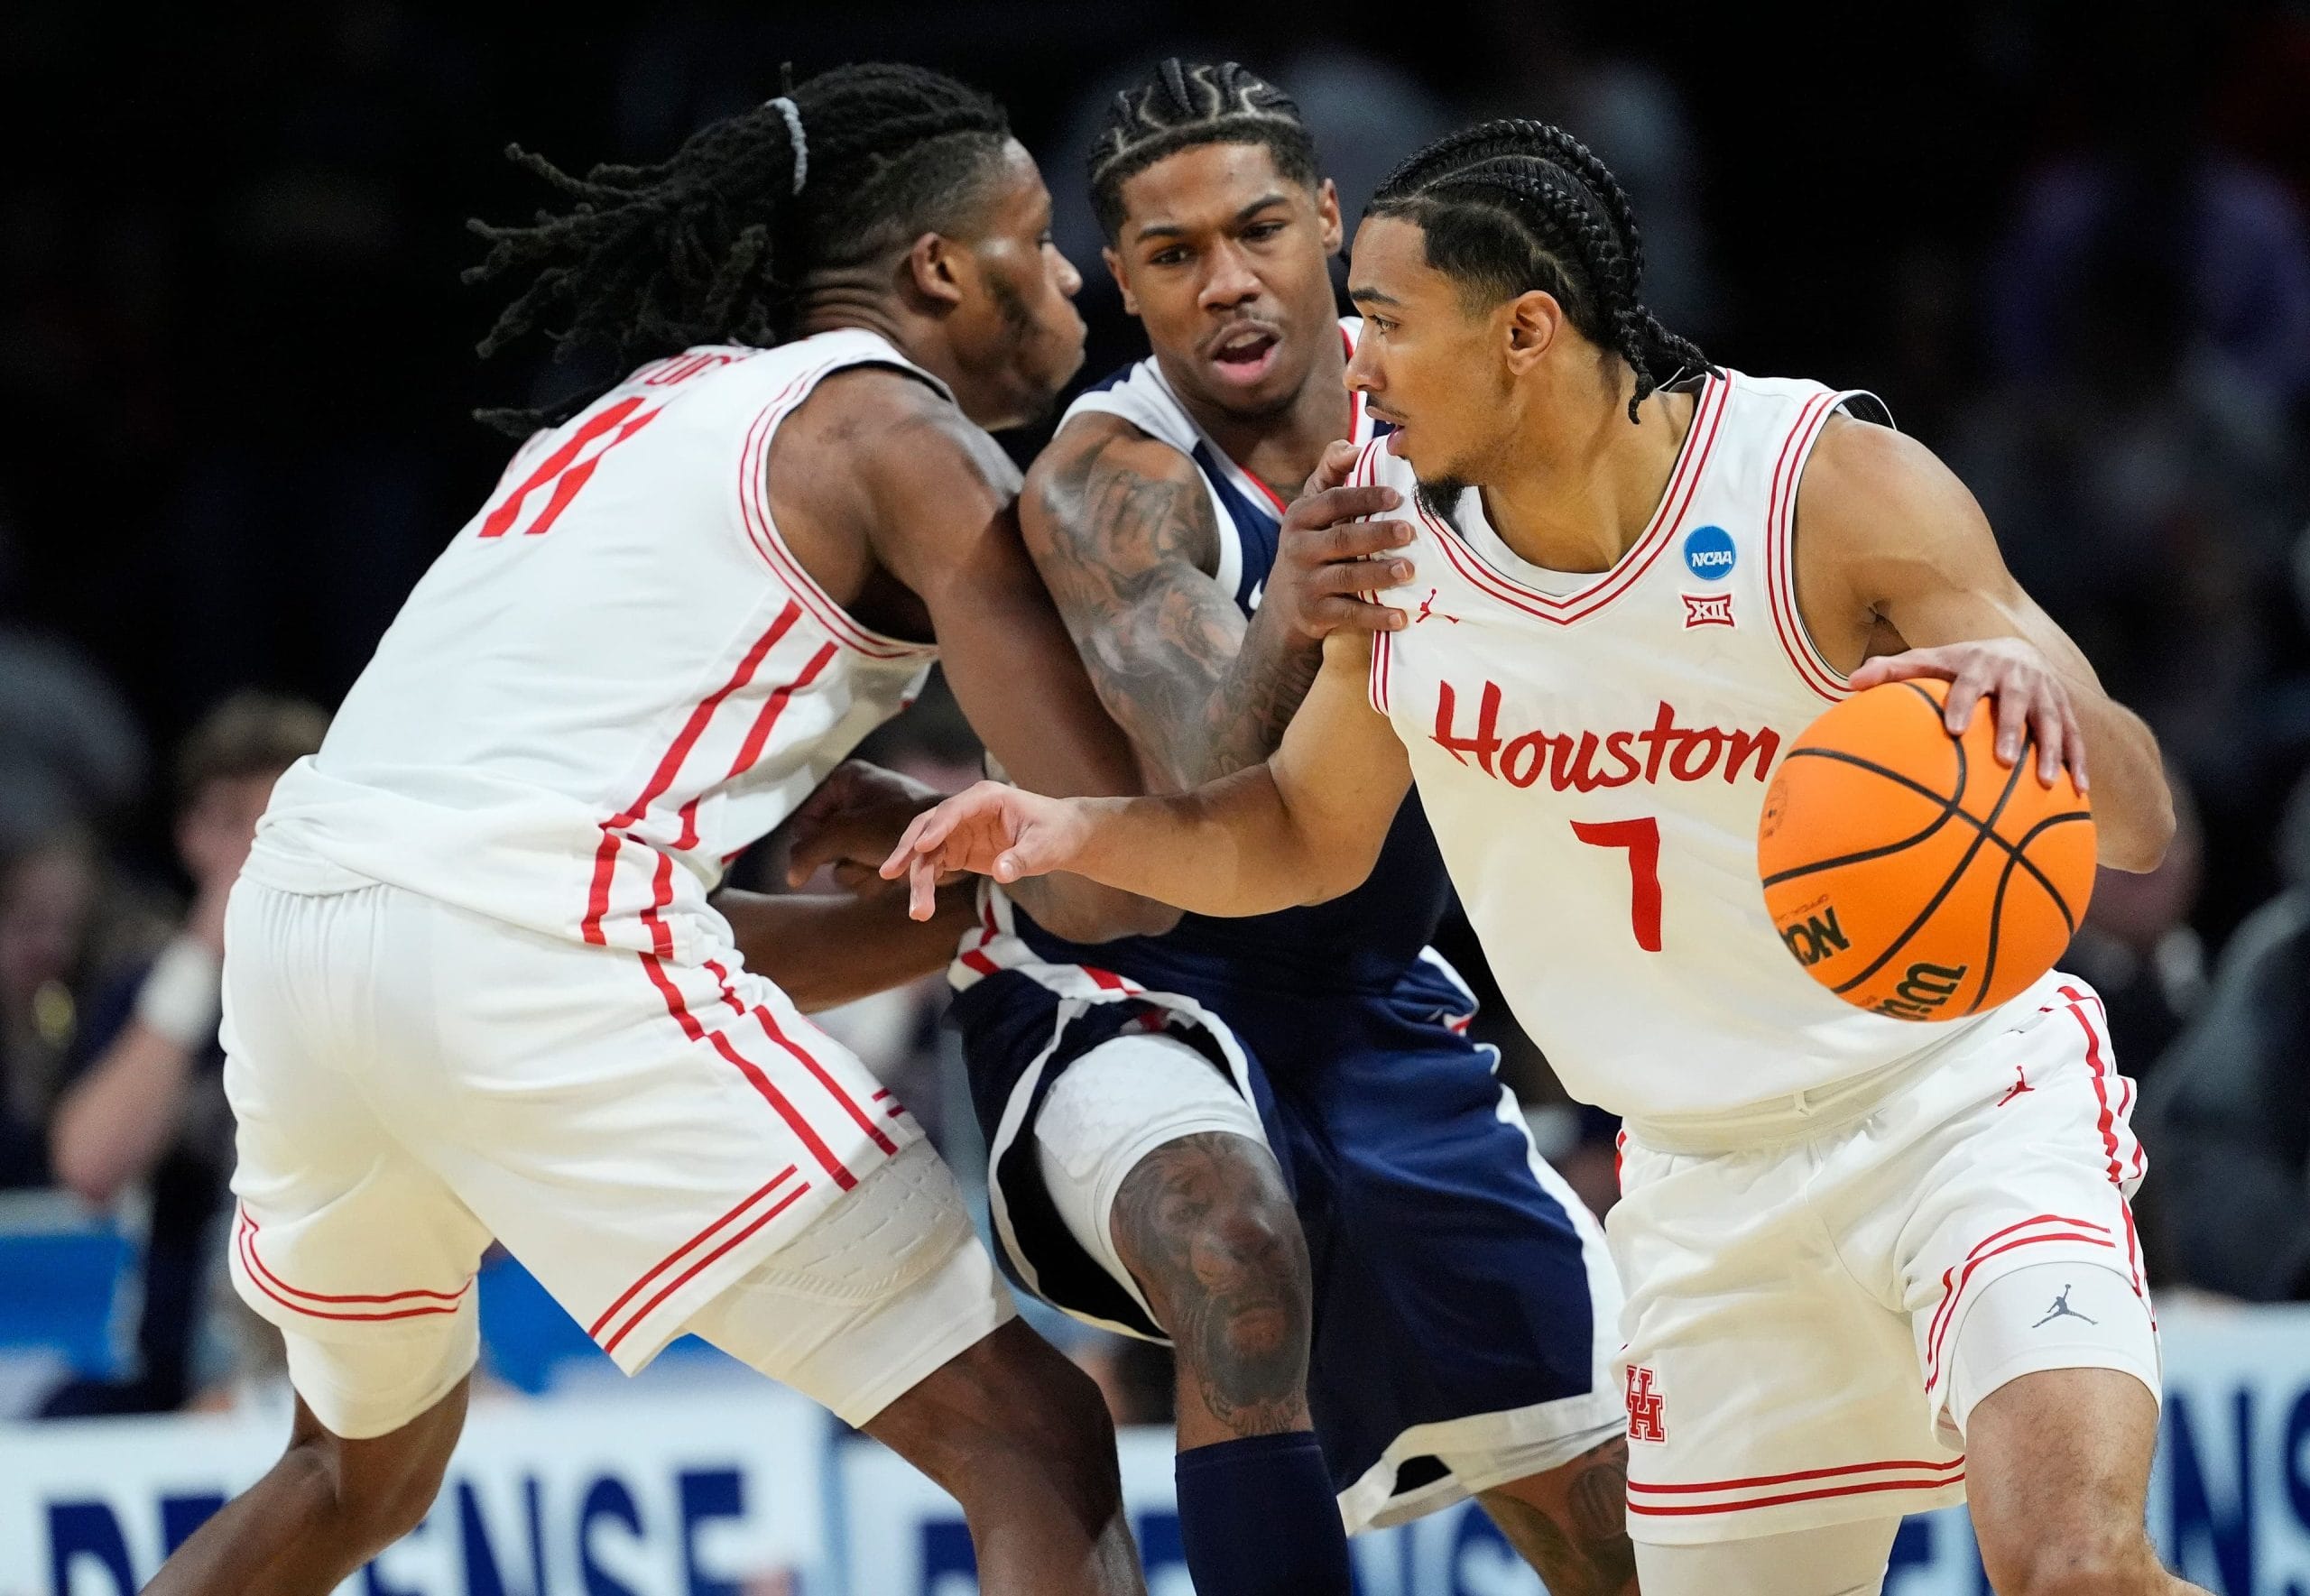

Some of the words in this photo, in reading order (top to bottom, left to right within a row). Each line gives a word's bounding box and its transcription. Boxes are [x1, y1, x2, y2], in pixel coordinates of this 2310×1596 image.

[478, 396, 663, 538] 11
[1686, 598, 1732, 623] XII
[1691, 550, 1732, 567] NCAA
[1428, 679, 1781, 793] Houston
[1570, 816, 1662, 952] 7
